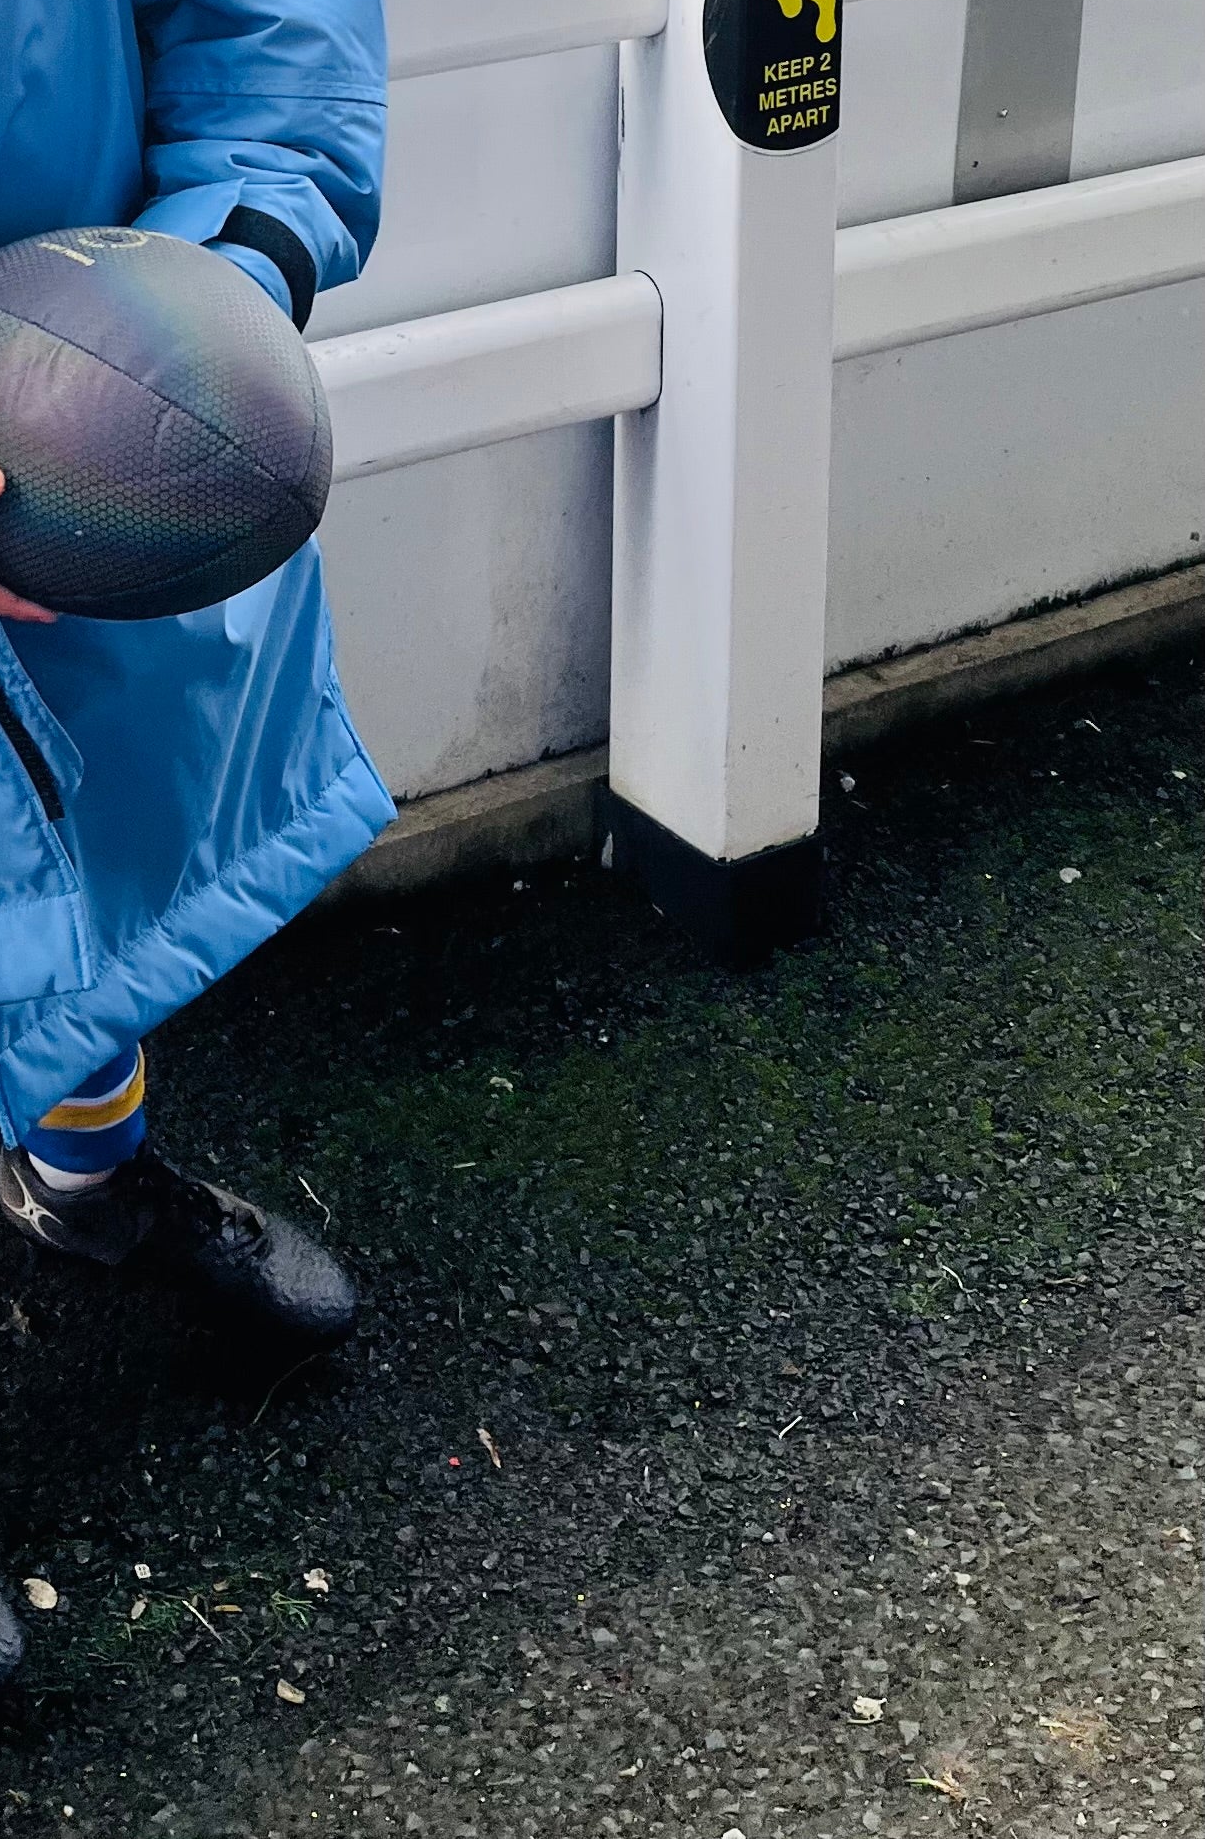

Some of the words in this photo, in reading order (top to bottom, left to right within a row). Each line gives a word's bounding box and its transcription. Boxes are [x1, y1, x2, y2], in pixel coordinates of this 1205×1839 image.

[764, 57, 815, 83] KEEP
[820, 52, 832, 72] 2
[759, 77, 838, 112] METRES
[766, 105, 831, 137] APART
